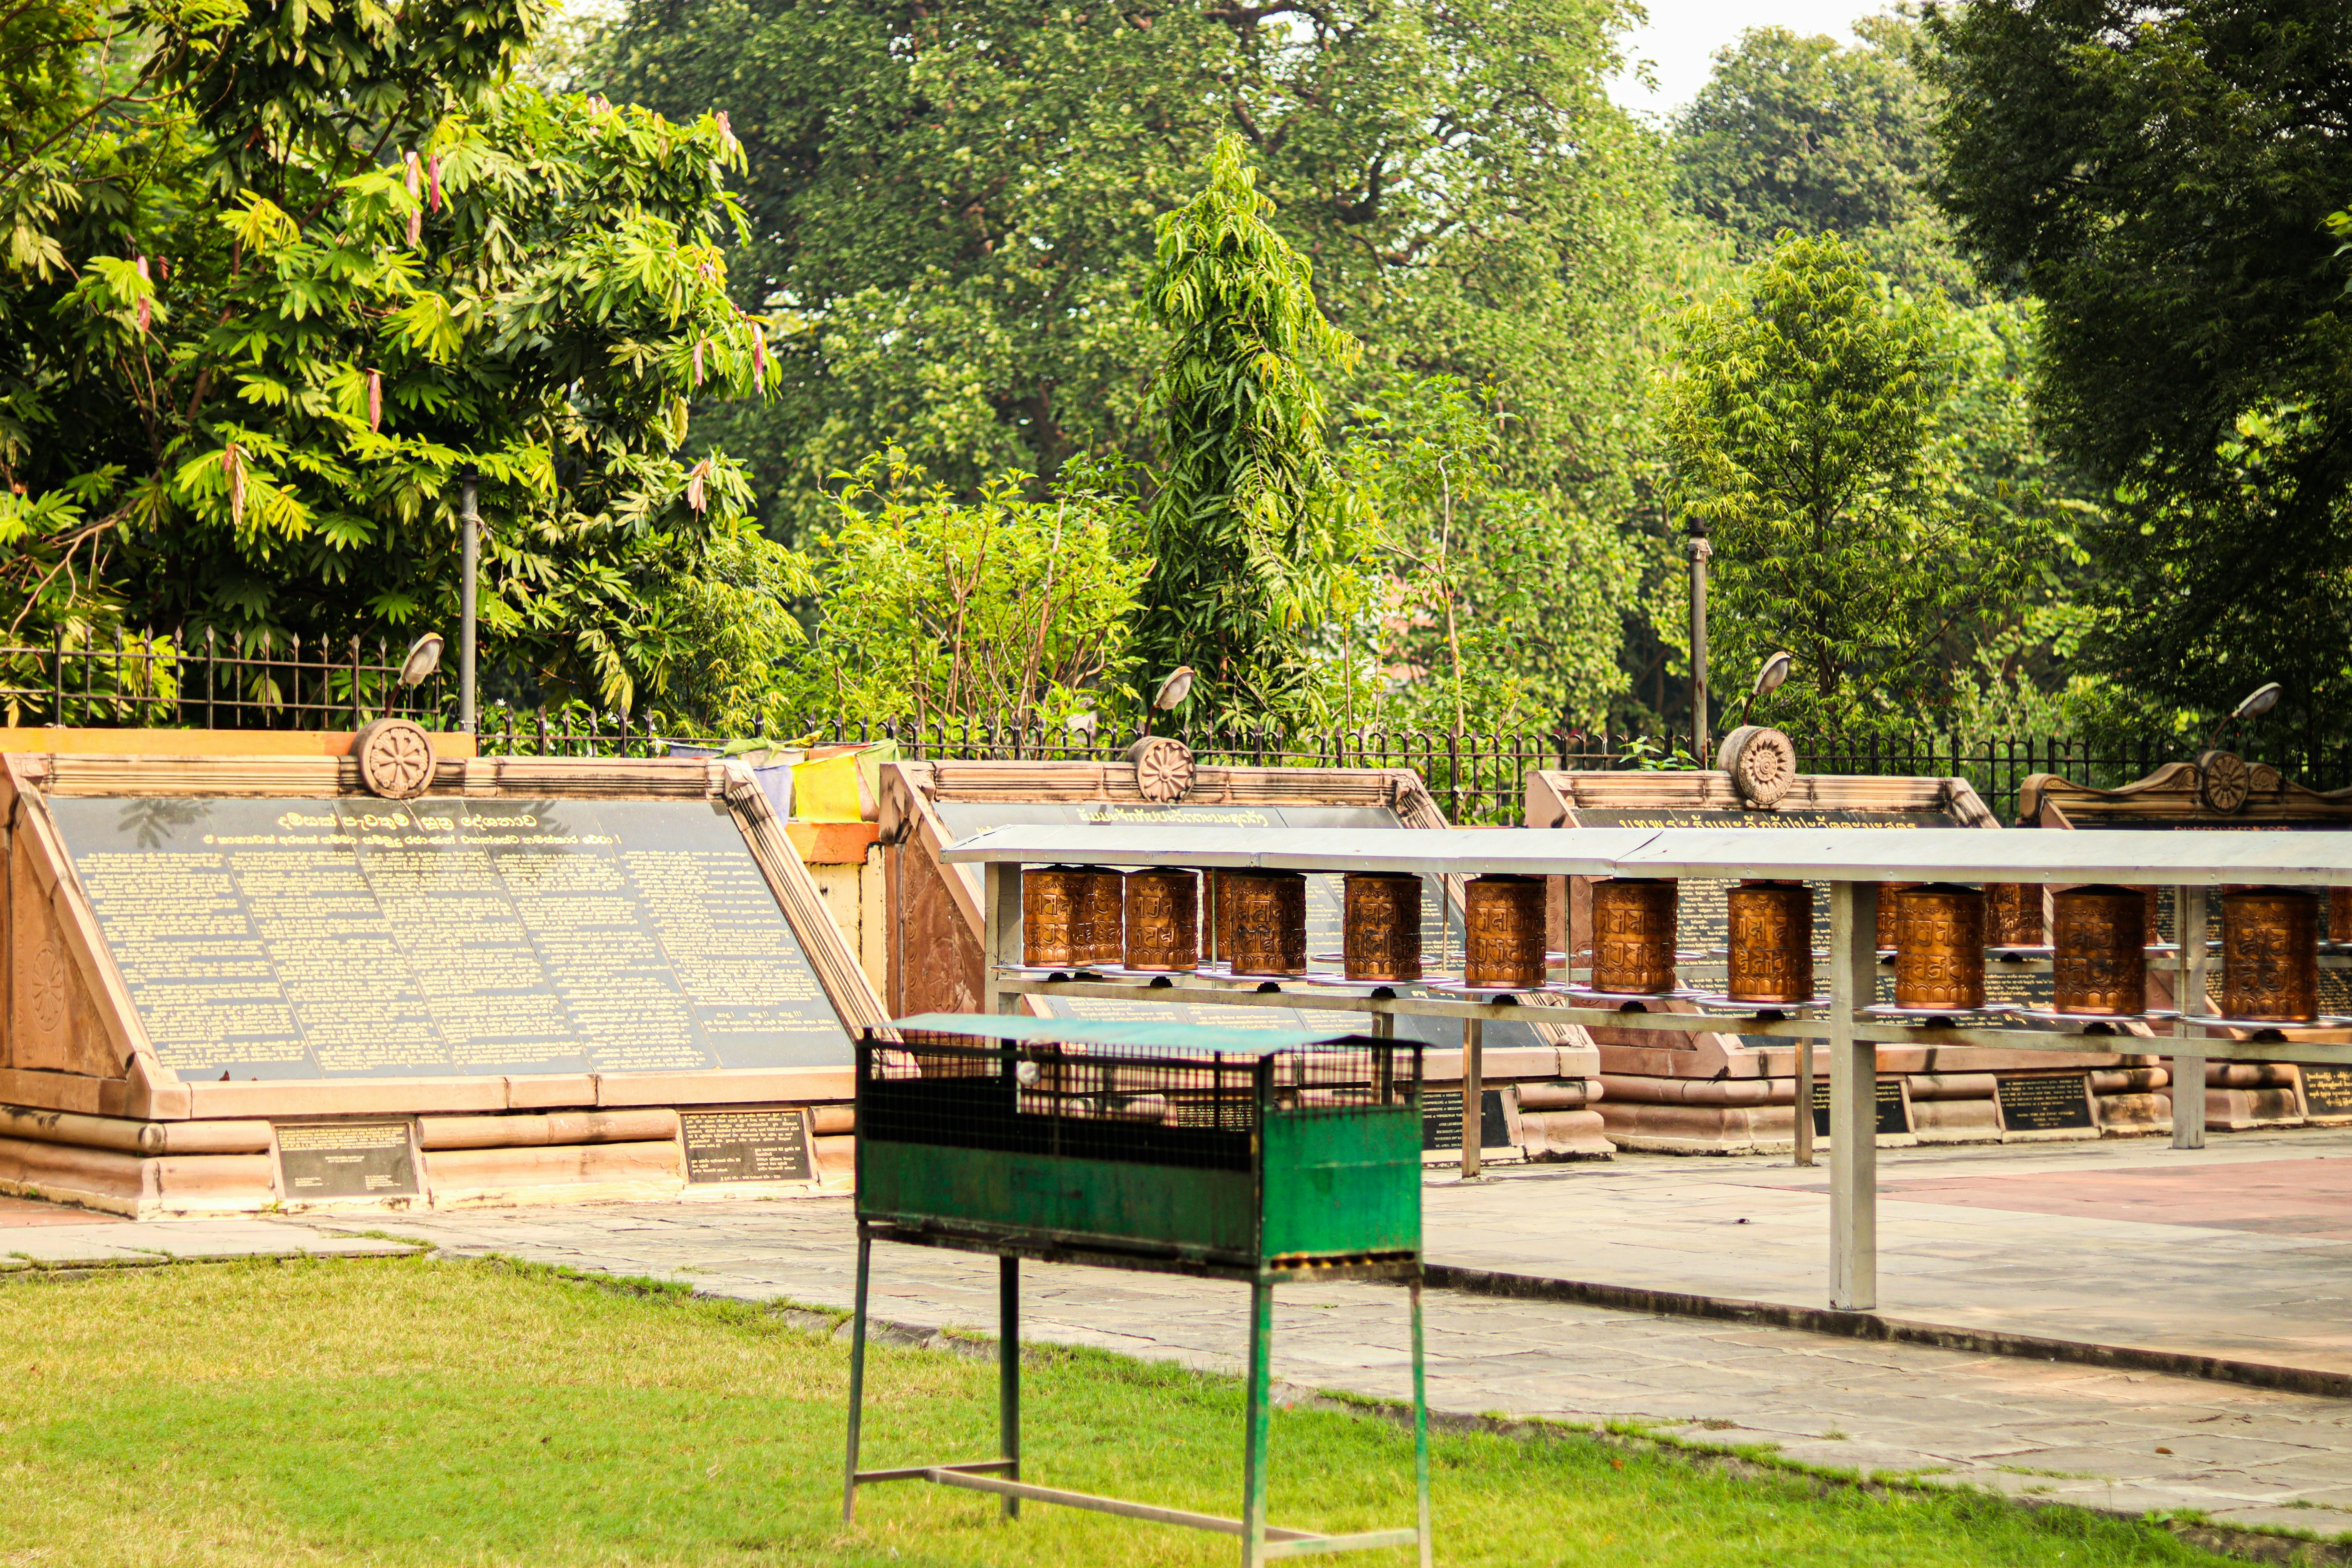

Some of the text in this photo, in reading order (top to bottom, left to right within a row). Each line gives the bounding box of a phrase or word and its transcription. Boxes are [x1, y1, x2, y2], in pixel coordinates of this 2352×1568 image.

[278, 812, 338, 830] දම්සක්
[342, 812, 410, 831] පැවතුම්
[460, 813, 537, 831] දේශනාව
